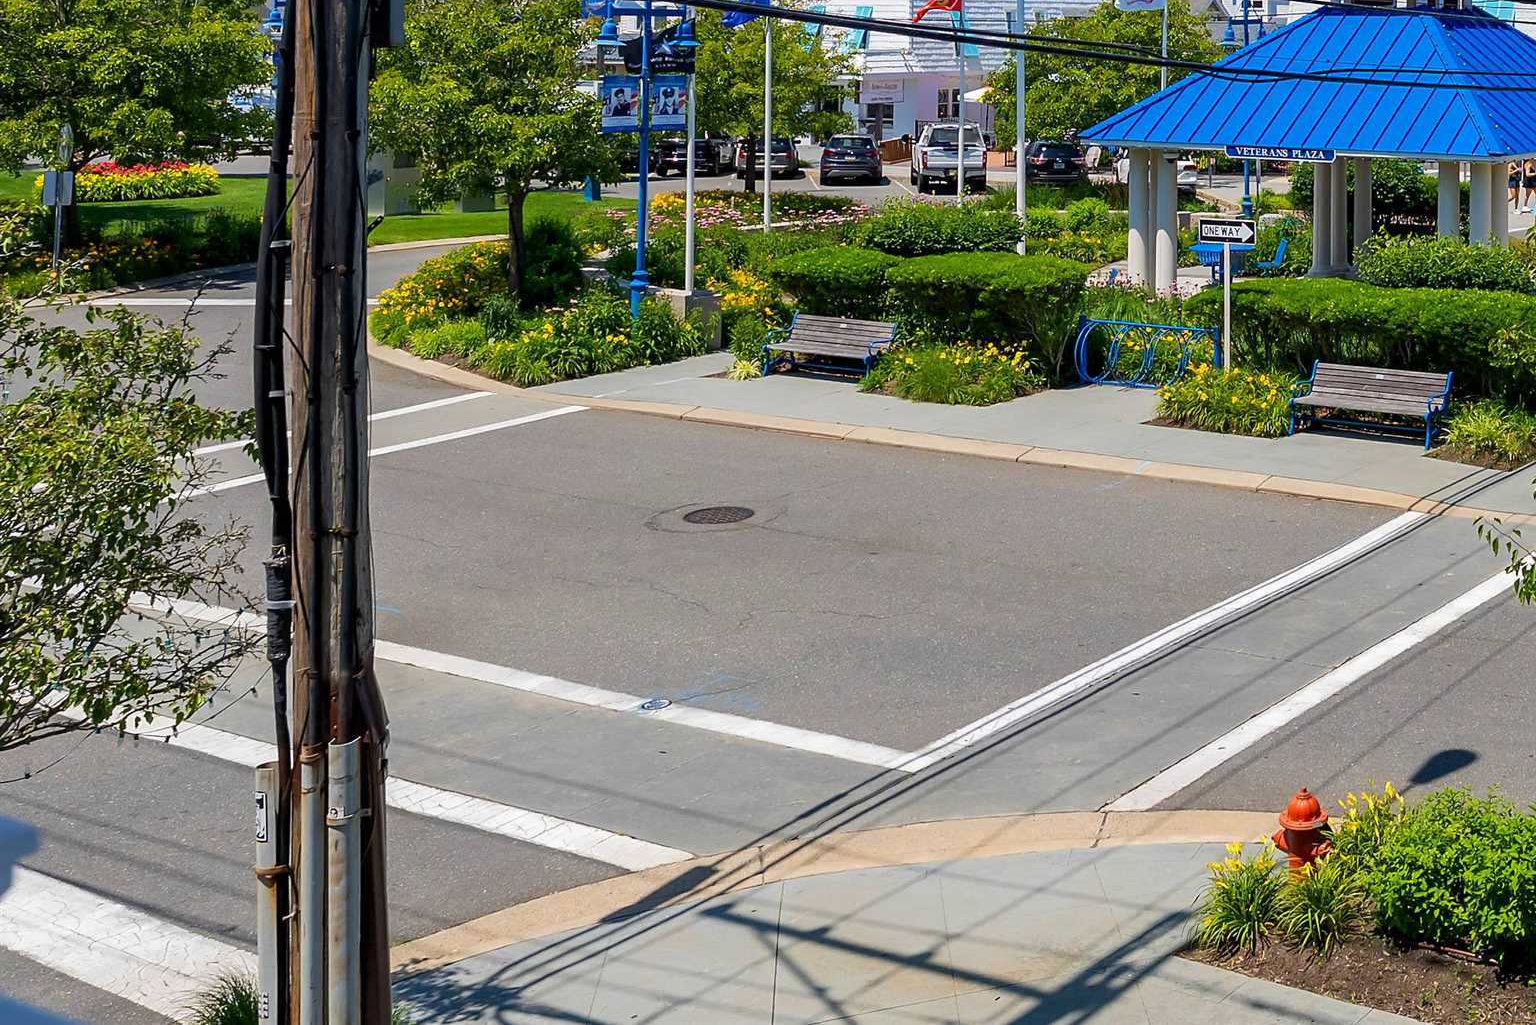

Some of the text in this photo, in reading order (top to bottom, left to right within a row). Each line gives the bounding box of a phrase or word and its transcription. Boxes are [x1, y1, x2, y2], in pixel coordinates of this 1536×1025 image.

[1235, 146, 1326, 160] VETERANS PLAZA
[1203, 226, 1242, 237] ONE WAY
